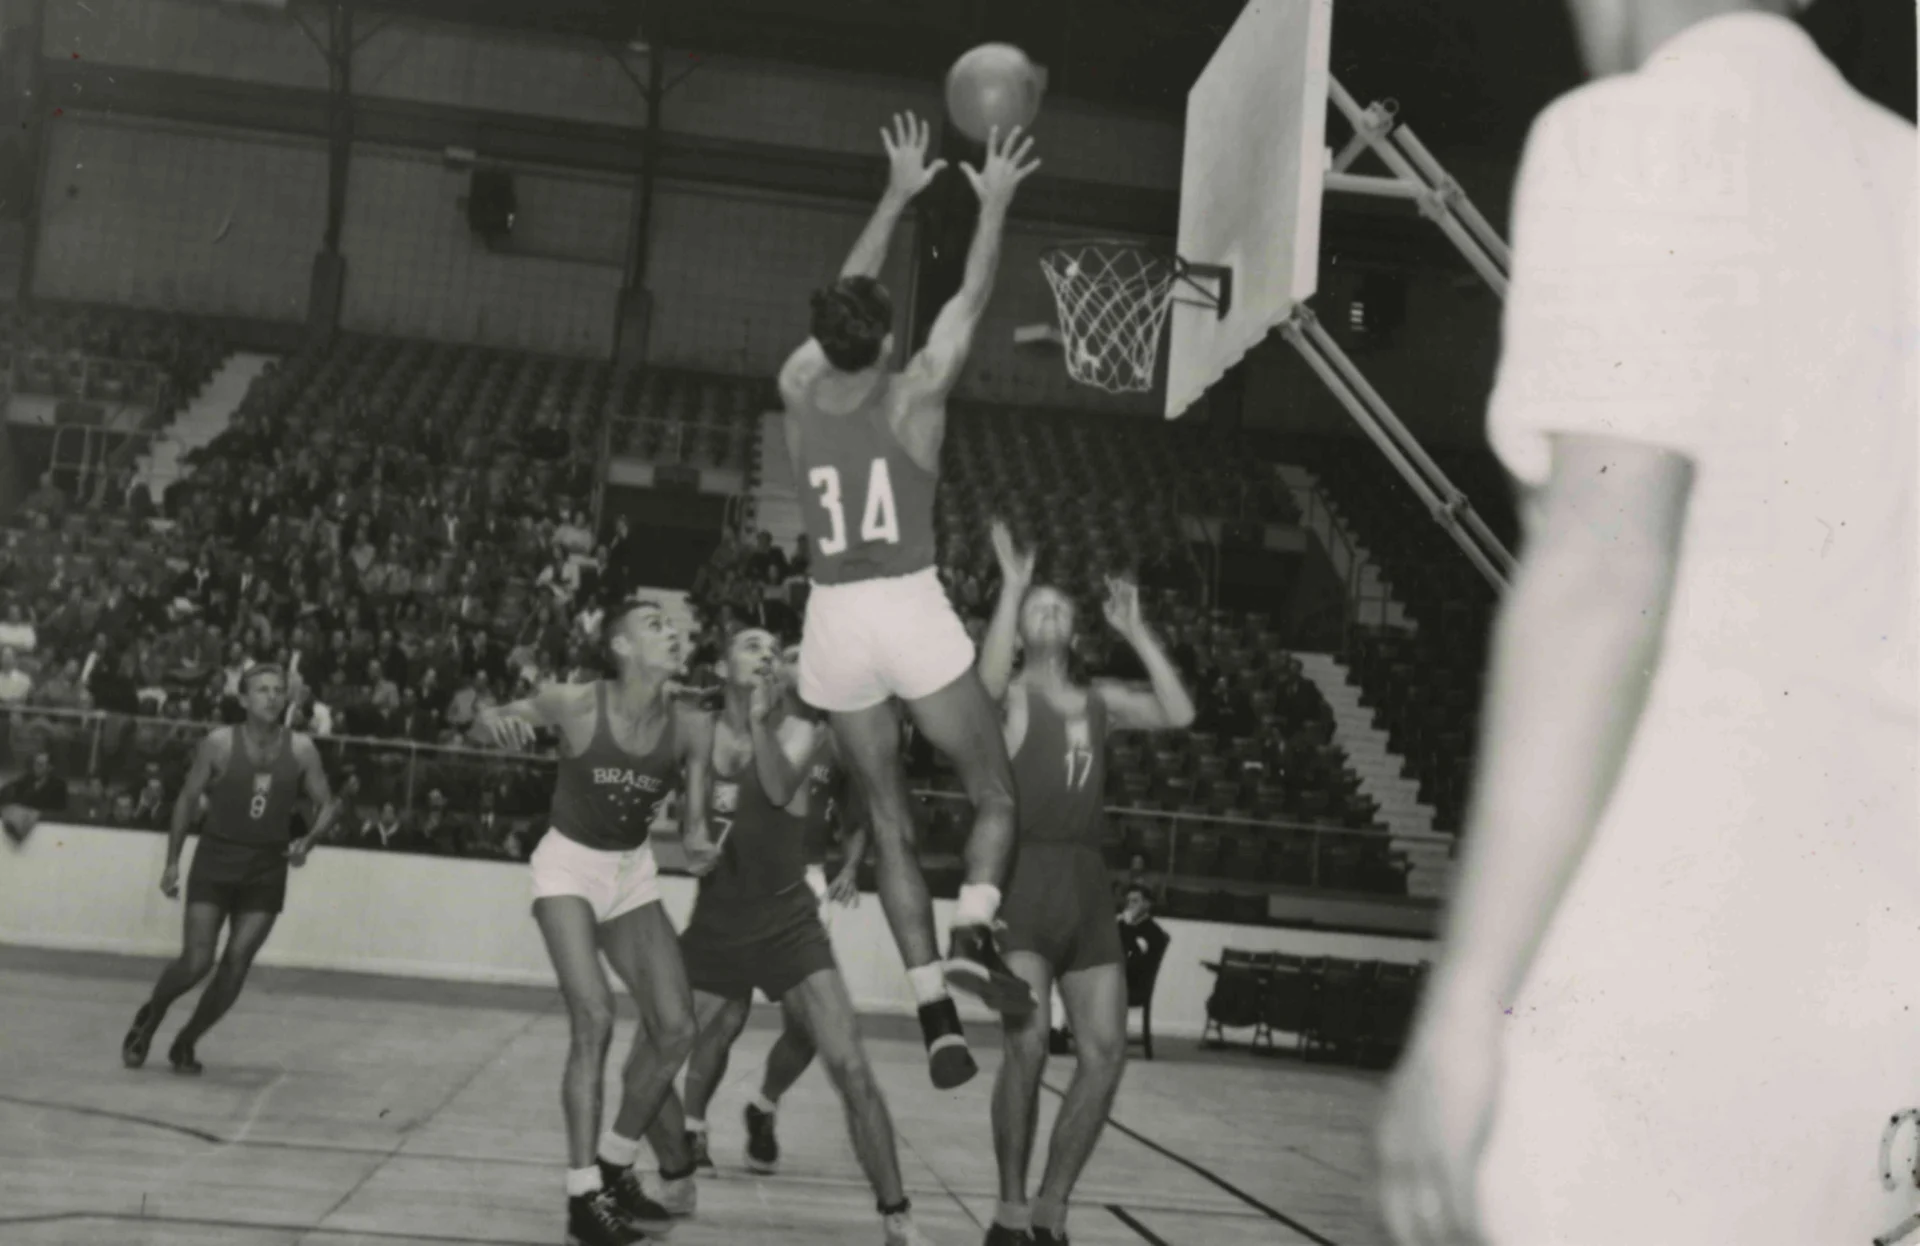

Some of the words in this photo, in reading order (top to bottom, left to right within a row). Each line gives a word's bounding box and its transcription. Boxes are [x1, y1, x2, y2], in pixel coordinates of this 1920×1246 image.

[808, 457, 899, 556] 34
[1065, 751, 1093, 790] 17
[250, 795, 266, 819] 8
